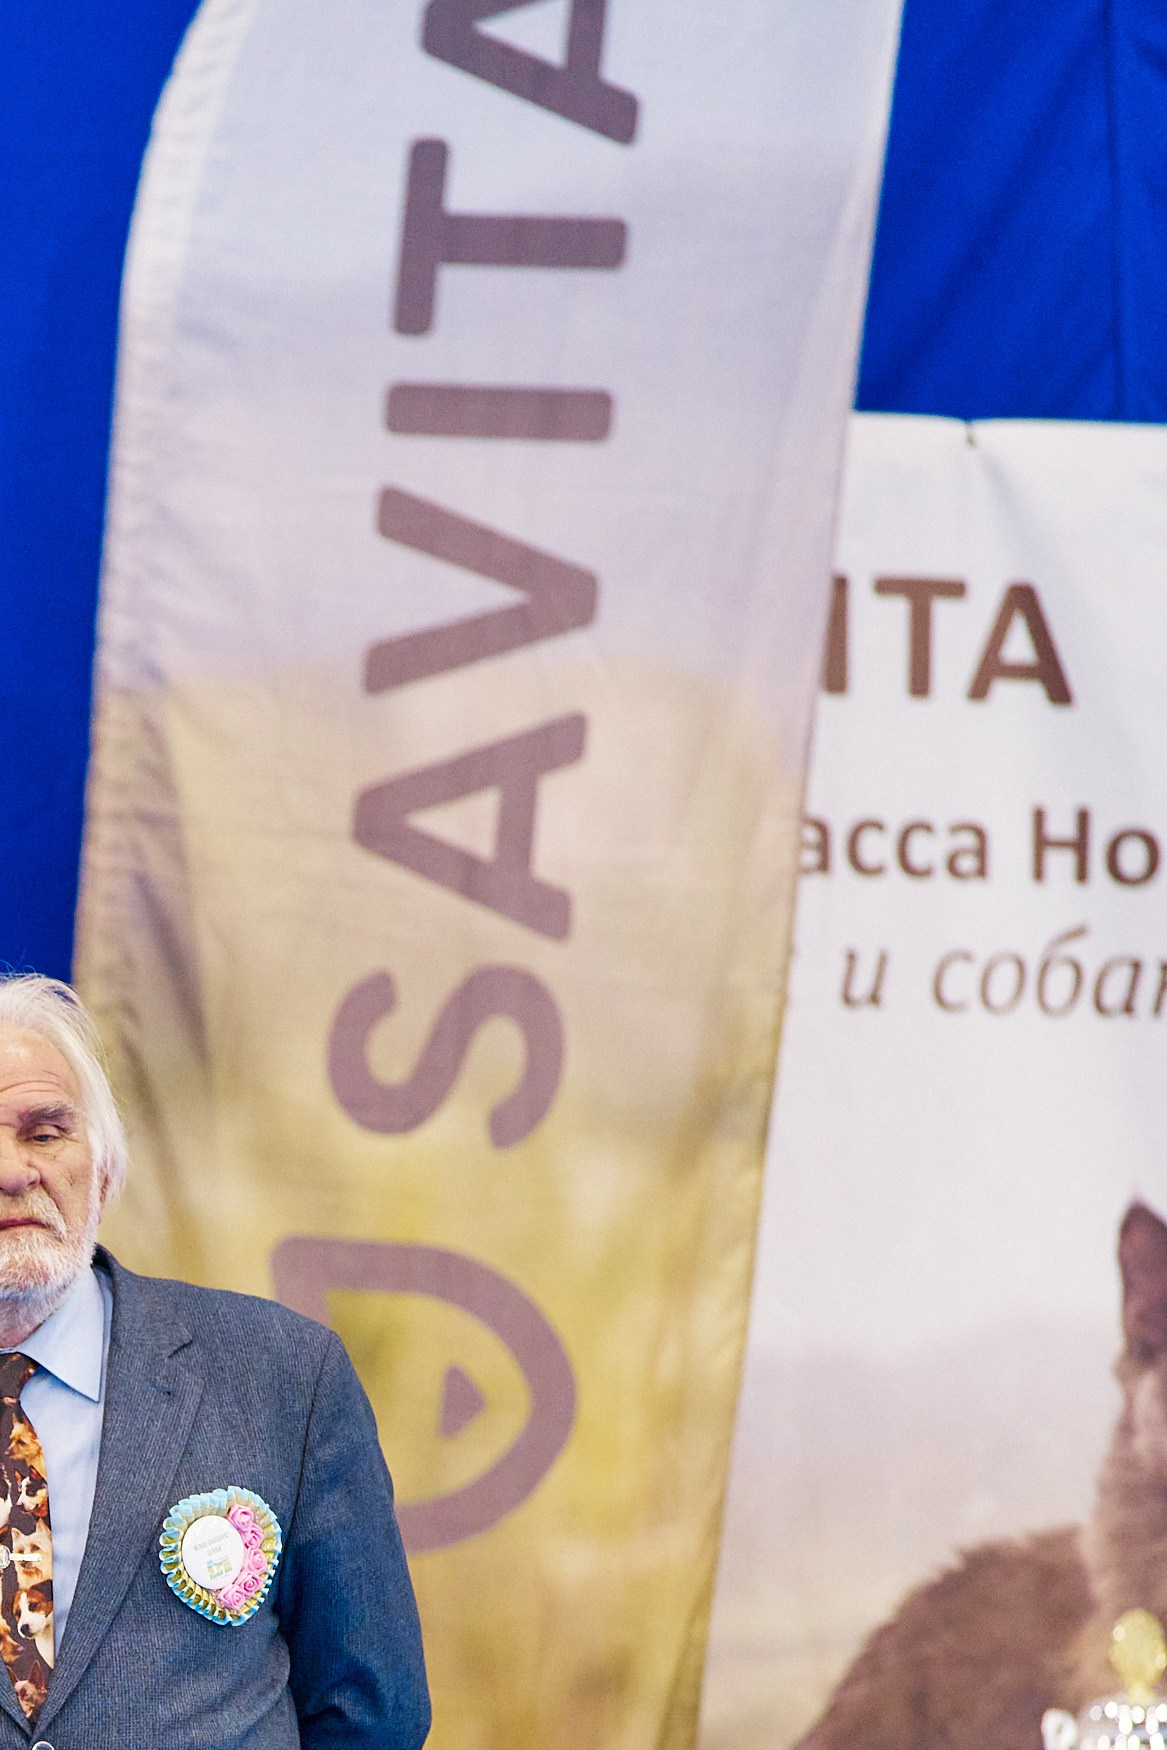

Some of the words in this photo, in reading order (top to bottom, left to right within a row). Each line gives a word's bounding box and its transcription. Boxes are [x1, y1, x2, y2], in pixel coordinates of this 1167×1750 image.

[326, 0, 639, 1150] SAVITA
[1031, 805, 1161, 888] Но
[841, 946, 888, 1009] и
